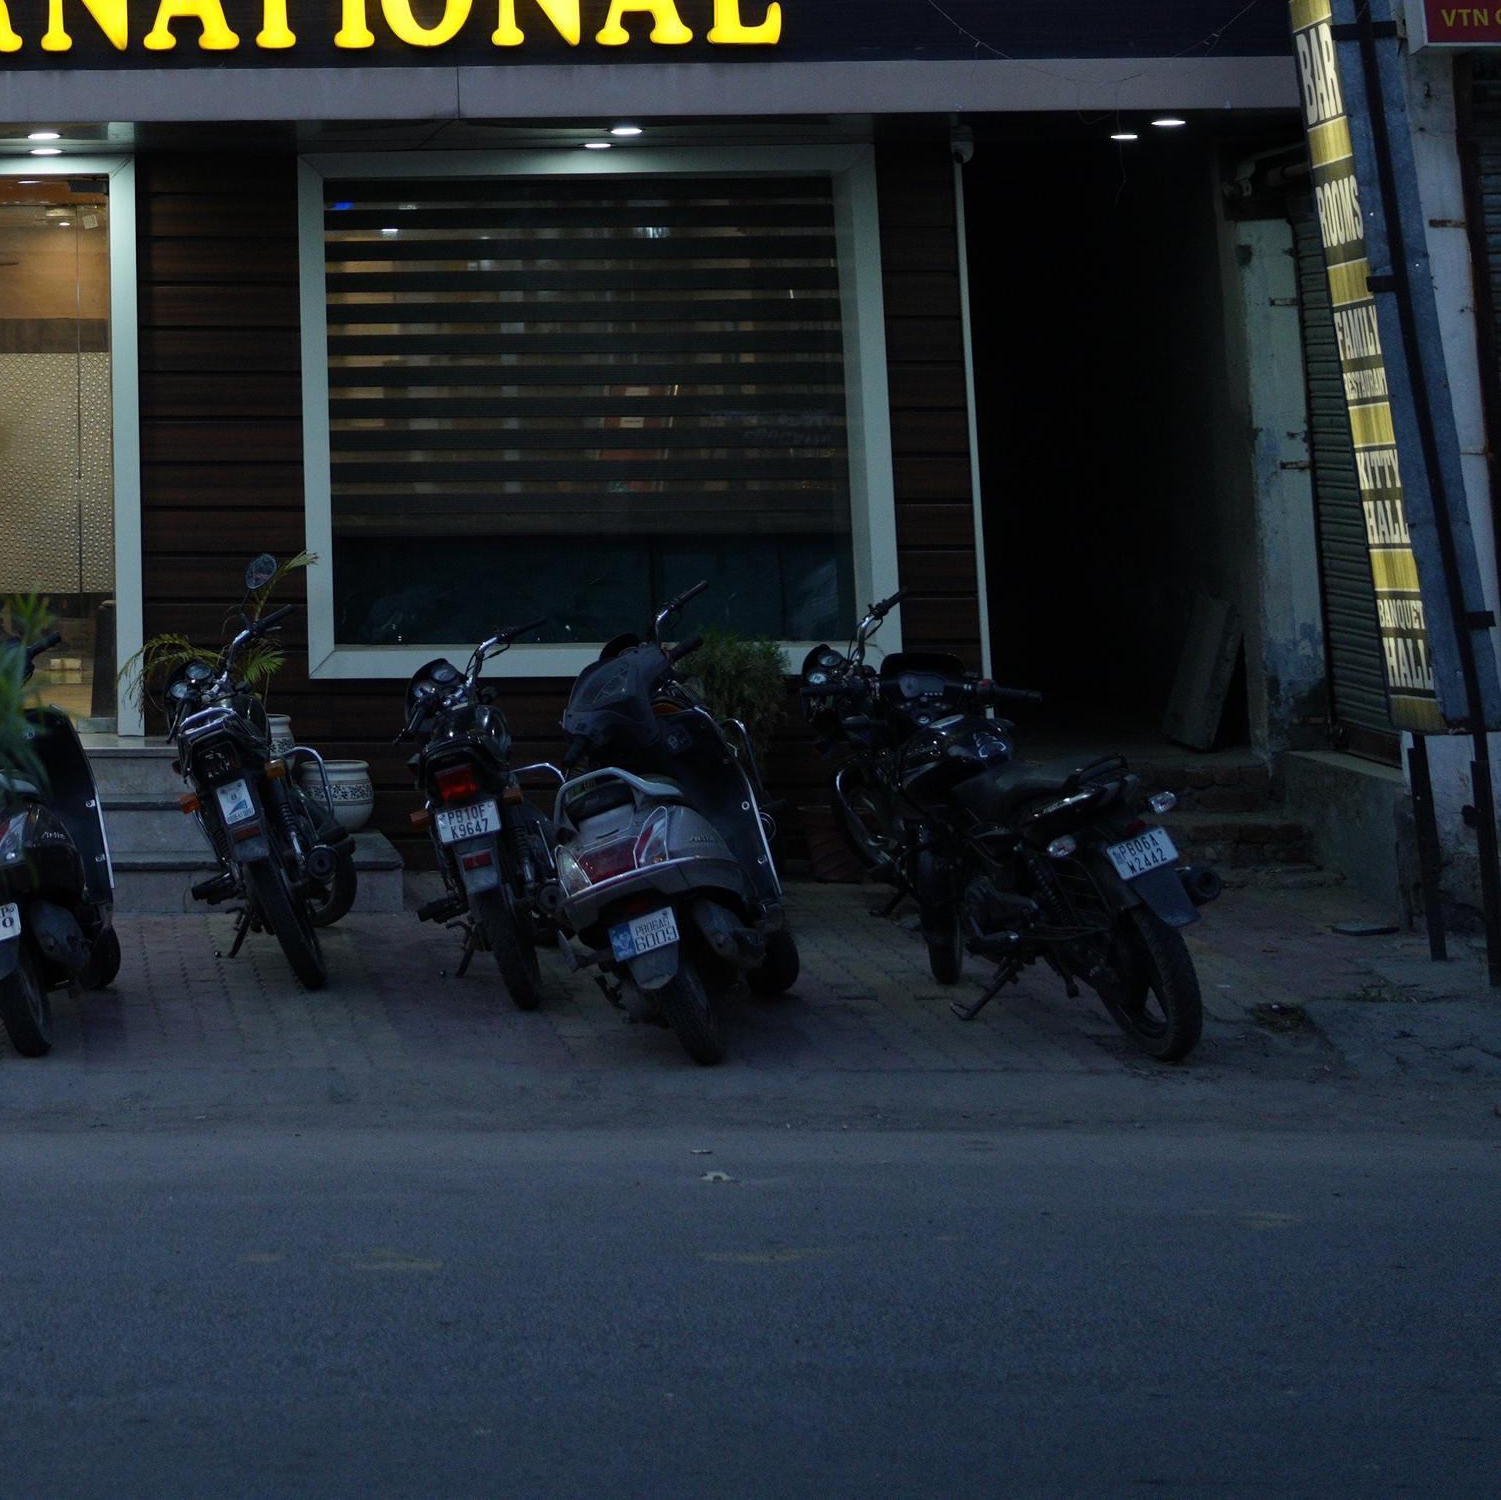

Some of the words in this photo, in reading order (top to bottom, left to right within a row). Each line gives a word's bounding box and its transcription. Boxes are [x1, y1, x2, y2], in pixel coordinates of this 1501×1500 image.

[1440, 8, 1489, 27] VTN
[1296, 22, 1343, 126] BAR
[1315, 174, 1364, 248] ROOMS
[1333, 304, 1382, 361] FAMILY
[1343, 366, 1389, 401] RESTAURANT
[1355, 448, 1402, 490] KITTY
[1362, 500, 1411, 544] HALL
[1376, 598, 1426, 631] BANQUET
[1382, 637, 1435, 690] HALL
[447, 804, 486, 826] PB10F
[450, 818, 489, 839] K9647
[1118, 833, 1160, 861] PB06A
[634, 925, 678, 952] 6009
